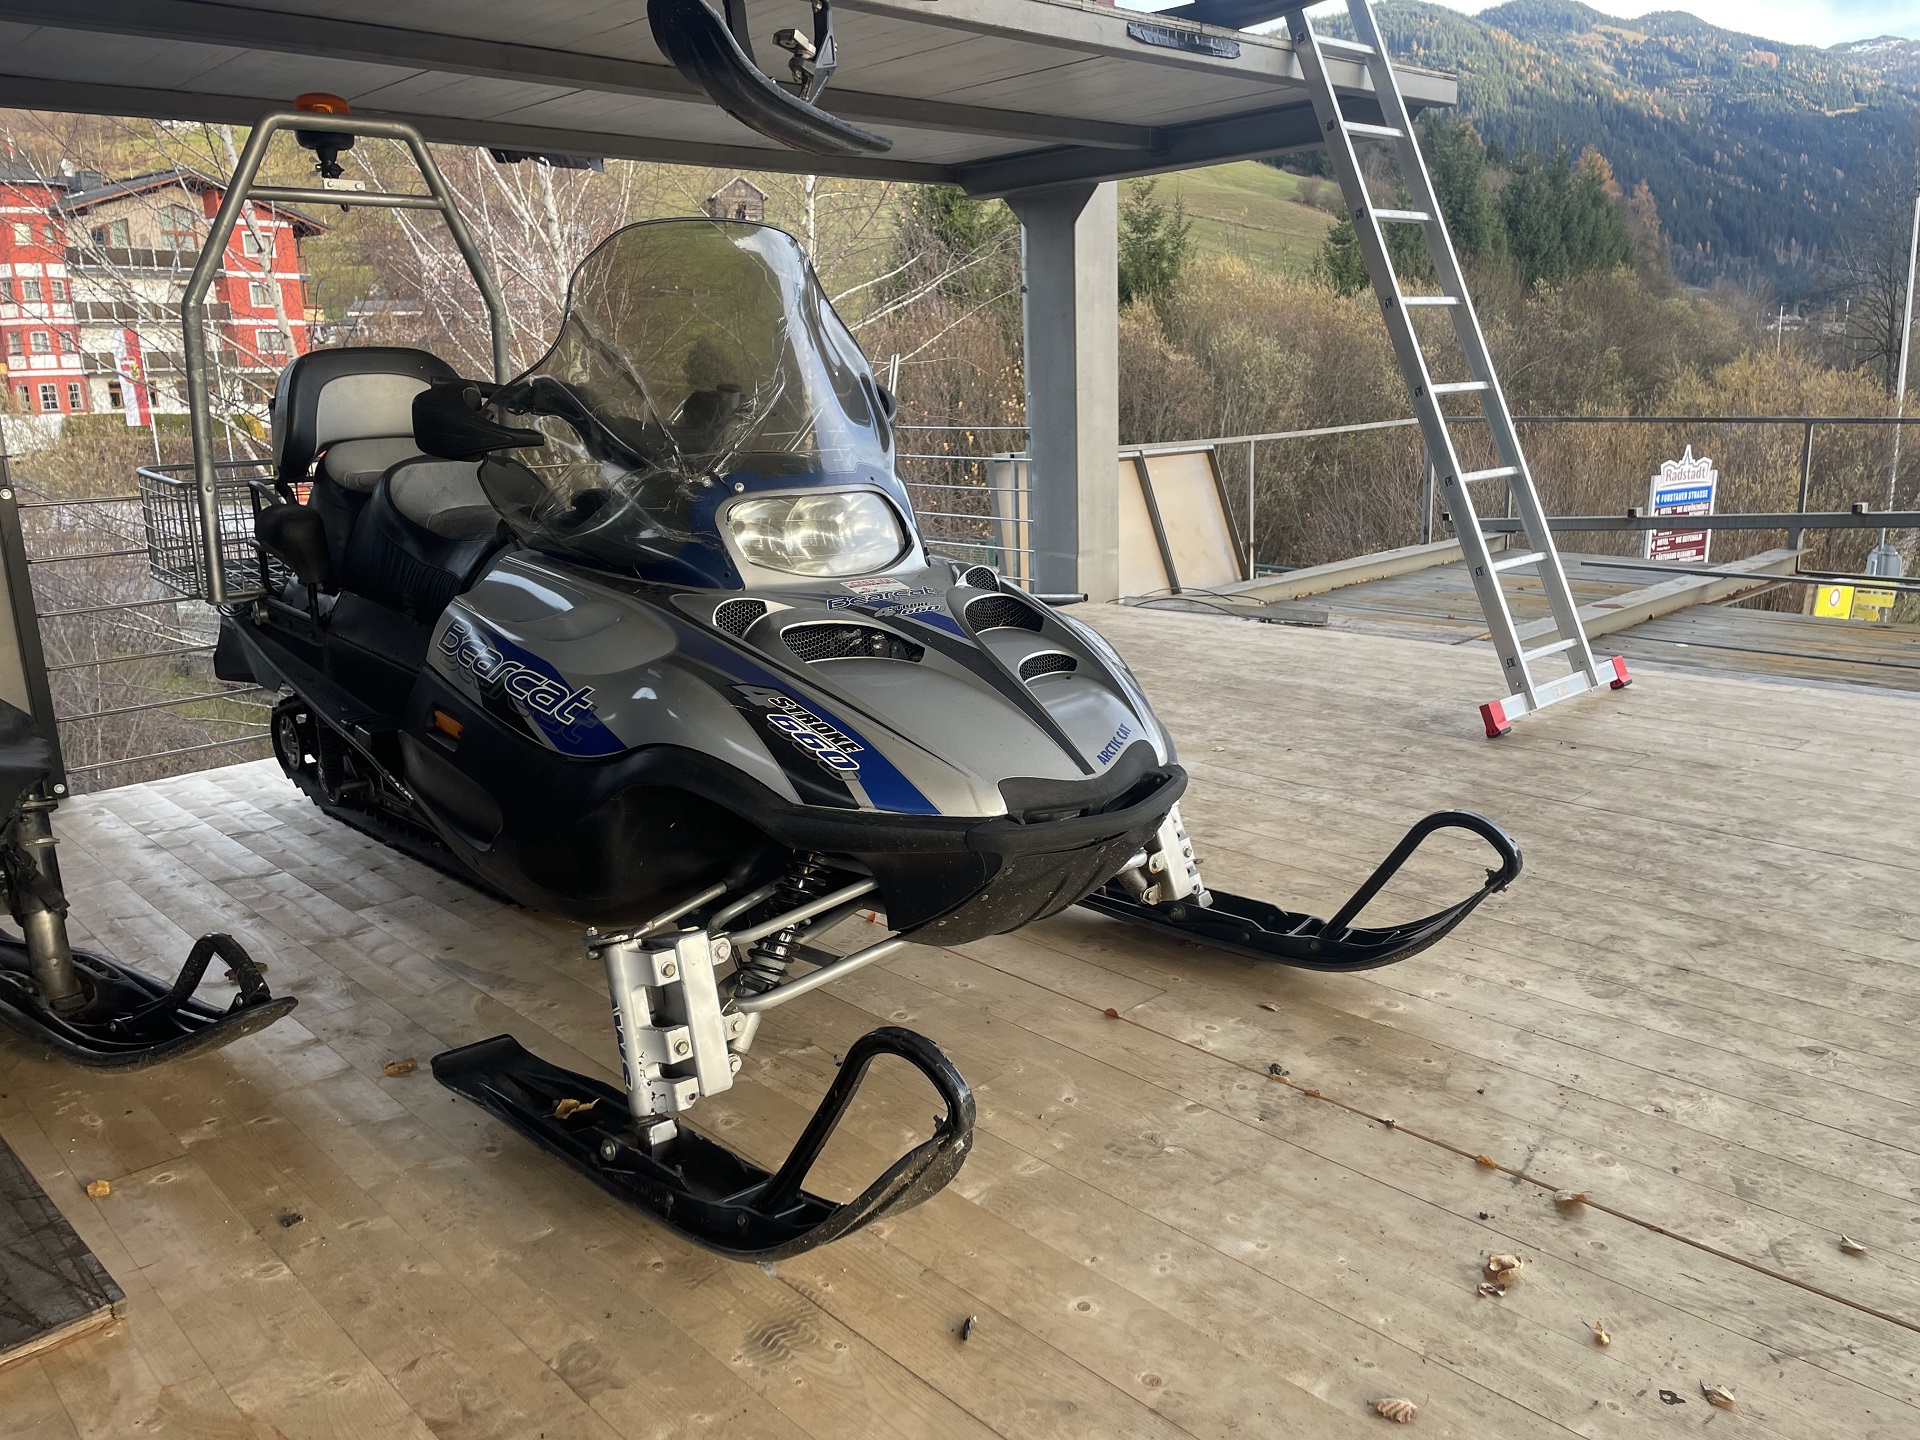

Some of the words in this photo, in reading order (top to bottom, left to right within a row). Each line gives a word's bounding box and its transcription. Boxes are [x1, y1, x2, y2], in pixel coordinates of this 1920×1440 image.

[1666, 466, 1706, 482] Radstadt
[1688, 489, 1708, 501] STRASSE
[827, 586, 935, 610] Bearcat
[437, 616, 596, 725] Bearcat
[730, 684, 787, 709] 4
[768, 696, 865, 753] STROKE
[766, 714, 860, 771] 660
[1097, 736, 1124, 765] ARCTIC
[1115, 722, 1131, 740] CAT
